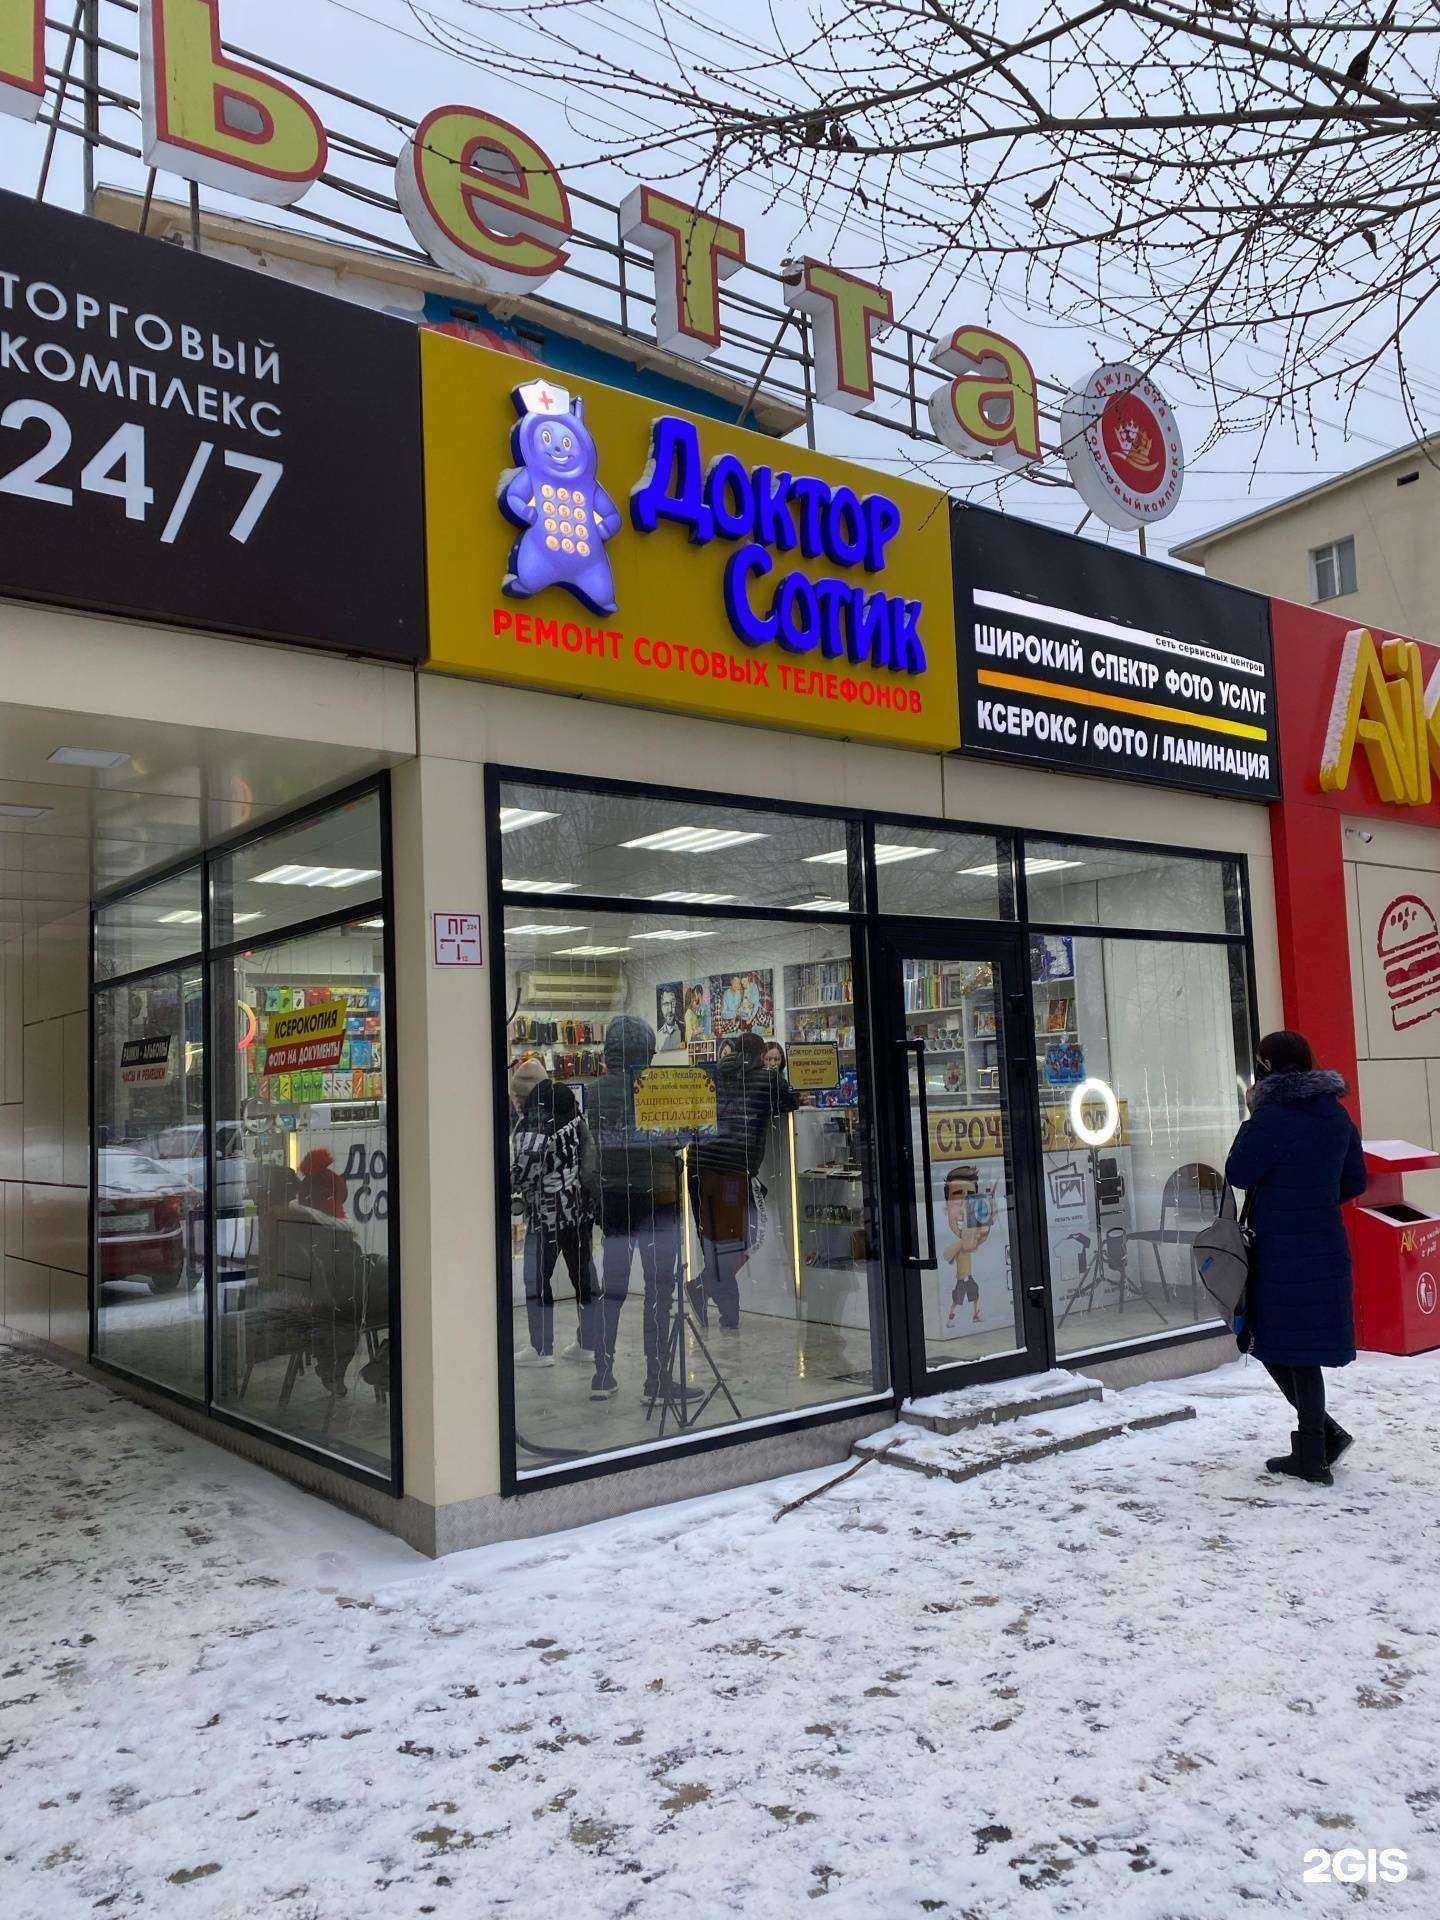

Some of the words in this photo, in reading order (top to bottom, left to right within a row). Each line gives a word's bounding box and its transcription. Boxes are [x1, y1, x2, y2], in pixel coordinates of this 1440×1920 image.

[0, 271, 281, 384] ТОРГОВЫЙ
[0, 330, 282, 438] КОМПЛЕКС
[0, 399, 284, 544] 24/7
[492, 608, 624, 661] РЕМОНТ
[633, 636, 769, 689] СОТОВЫХ
[777, 663, 923, 715] ТЕЛЕФОНОВ
[974, 623, 1085, 675] ШИРОКИЙ
[1090, 650, 1160, 690] СПЕКТР
[1165, 668, 1214, 703] ФОТО
[1218, 680, 1267, 716] УСЛУГ
[1155, 637, 1176, 649] сеть
[1178, 643, 1229, 664] сервисных
[1230, 656, 1263, 673] центров
[977, 700, 1078, 746] КСЕРОКС
[1093, 720, 1149, 758] ФОТО
[1162, 735, 1270, 782] ЛАМИНАЦИЯ
[448, 918, 468, 935] ПГ
[268, 1051, 286, 1067] ФОТО
[287, 1049, 297, 1065] НА
[298, 1041, 341, 1066] ДОКУМЕНТЫ
[274, 1009, 338, 1039] КСЕРОКОПИЯ
